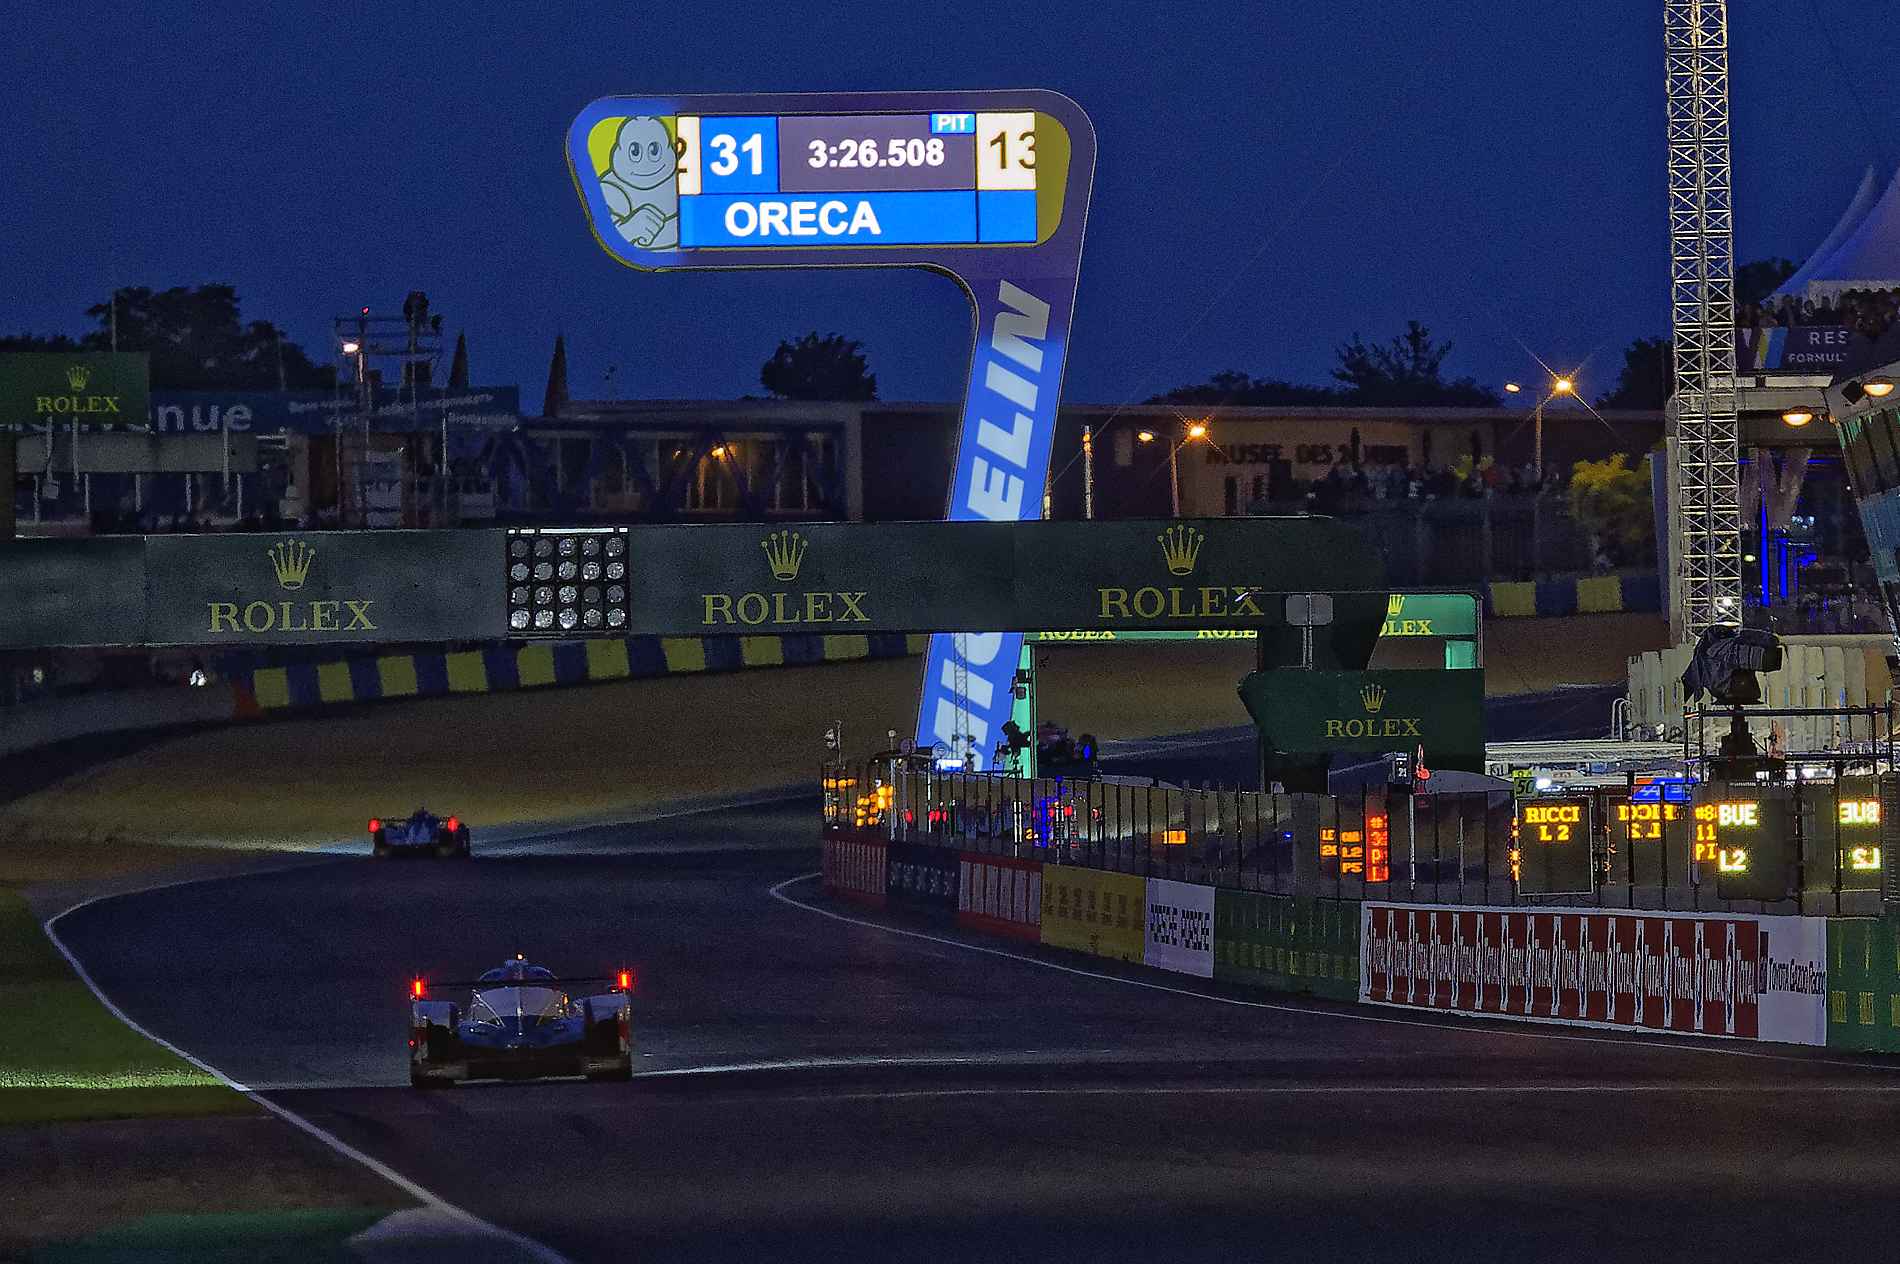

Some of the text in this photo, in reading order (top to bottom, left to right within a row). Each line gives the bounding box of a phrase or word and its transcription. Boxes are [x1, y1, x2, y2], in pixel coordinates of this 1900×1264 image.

[937, 115, 970, 131] PIT
[710, 133, 763, 176] 31
[808, 138, 945, 168] 3:26.508
[990, 131, 1036, 169] 13
[725, 200, 881, 237] ORECA
[1788, 352, 1848, 363] FORMUL
[36, 396, 120, 413] ROLEX
[702, 592, 872, 624] ROLEX
[1097, 586, 1264, 618] ROLEX
[208, 600, 378, 632] ROLEX
[1325, 718, 1422, 737] ROLEX
[1525, 805, 1580, 824] RICCI
[1719, 803, 1759, 827] BUE
[1720, 849, 1747, 873] L2
